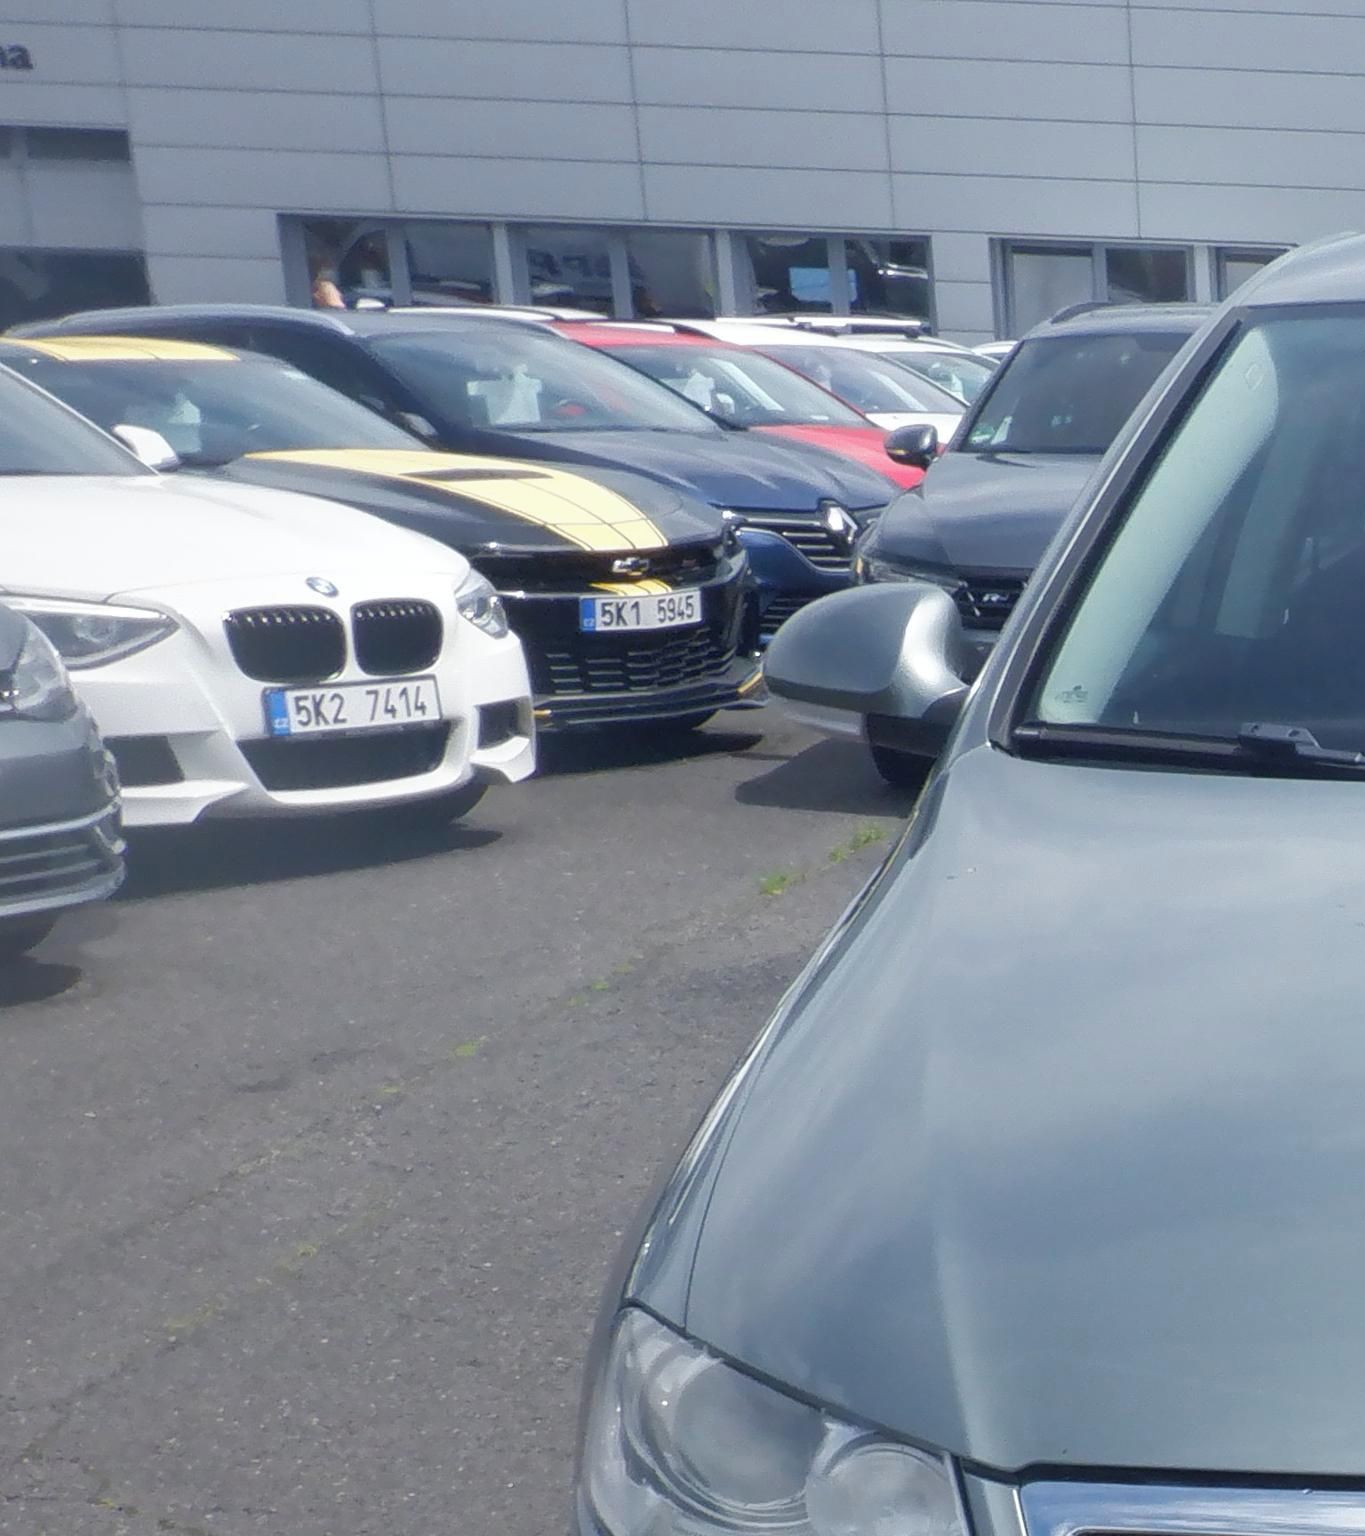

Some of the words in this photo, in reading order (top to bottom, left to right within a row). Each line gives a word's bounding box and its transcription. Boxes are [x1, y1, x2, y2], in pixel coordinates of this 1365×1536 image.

[0, 44, 33, 70] a
[601, 601, 641, 626] 5K1
[657, 595, 694, 623] 5945
[294, 692, 347, 726] 5K2
[366, 685, 427, 722] 7414
